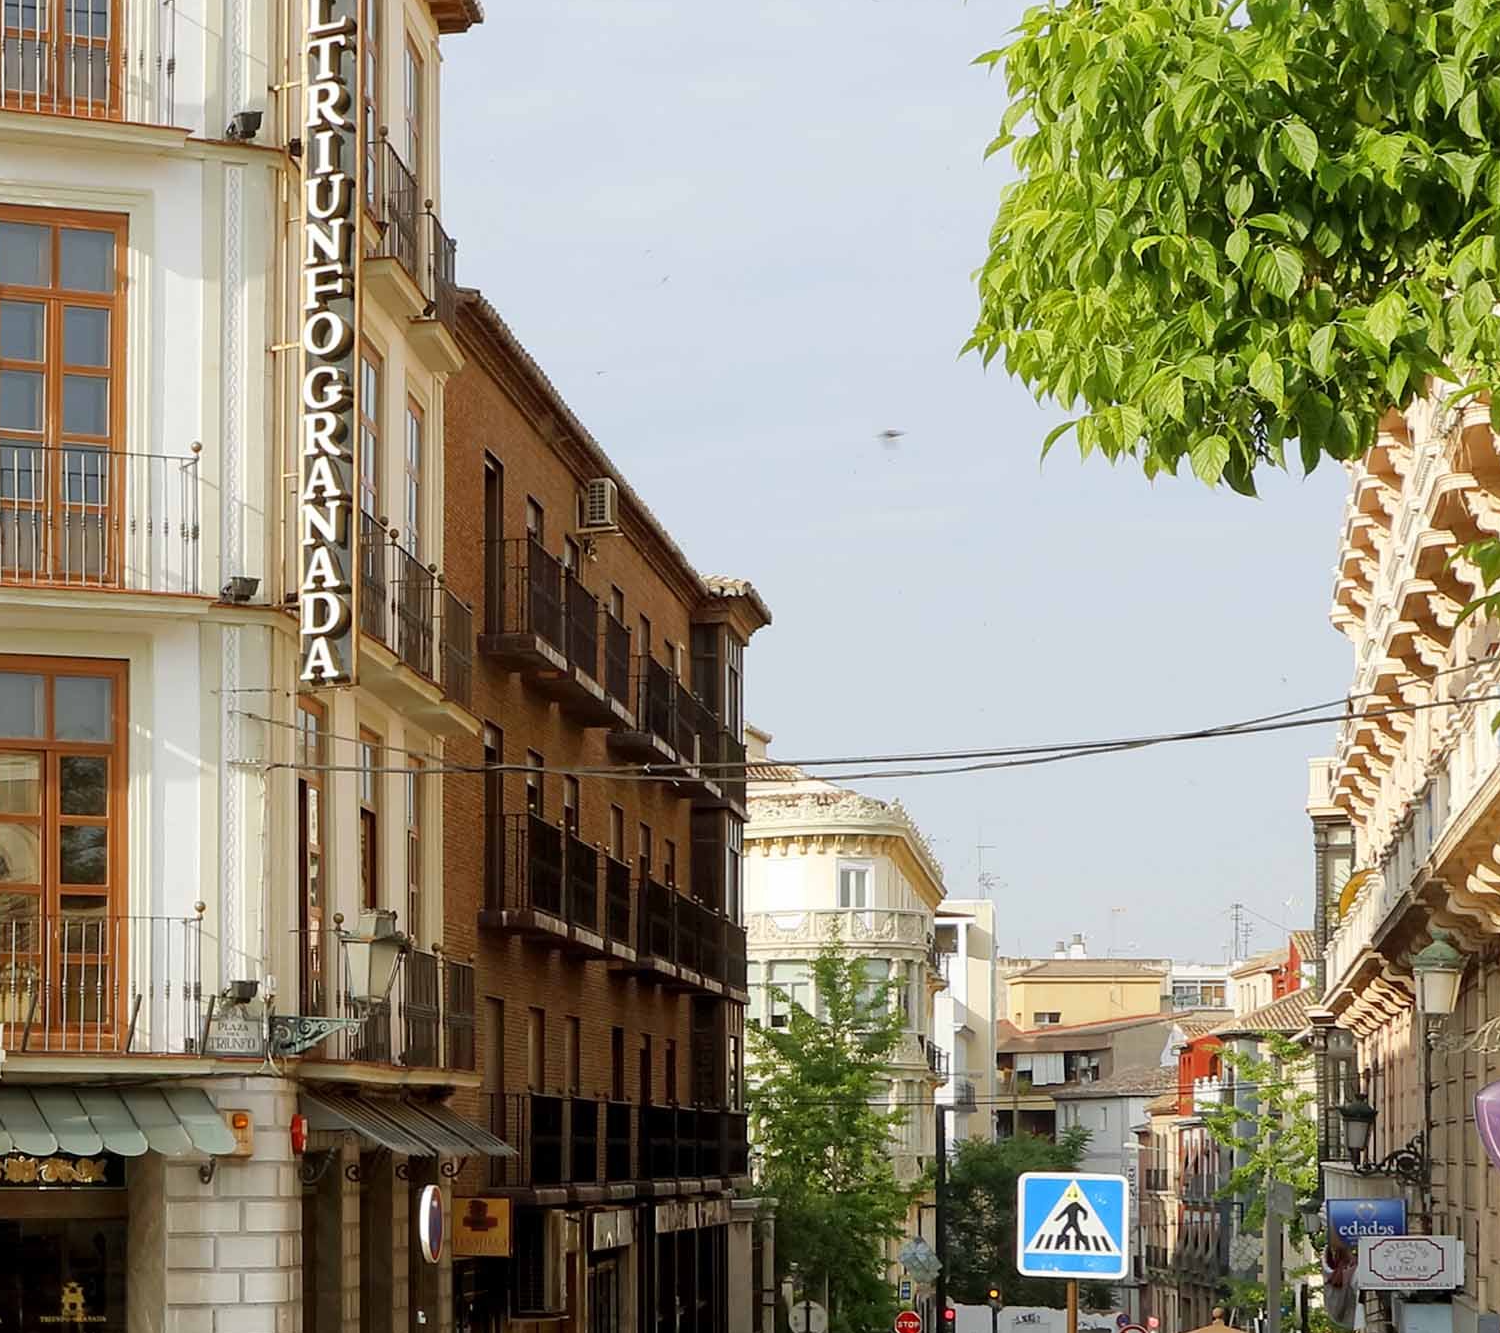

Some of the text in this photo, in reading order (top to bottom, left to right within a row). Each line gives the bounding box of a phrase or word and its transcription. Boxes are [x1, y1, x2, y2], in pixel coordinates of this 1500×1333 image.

[303, 35, 352, 356] TRIUNFO
[301, 365, 350, 682] GRANADA
[218, 1022, 249, 1032] PLAZA
